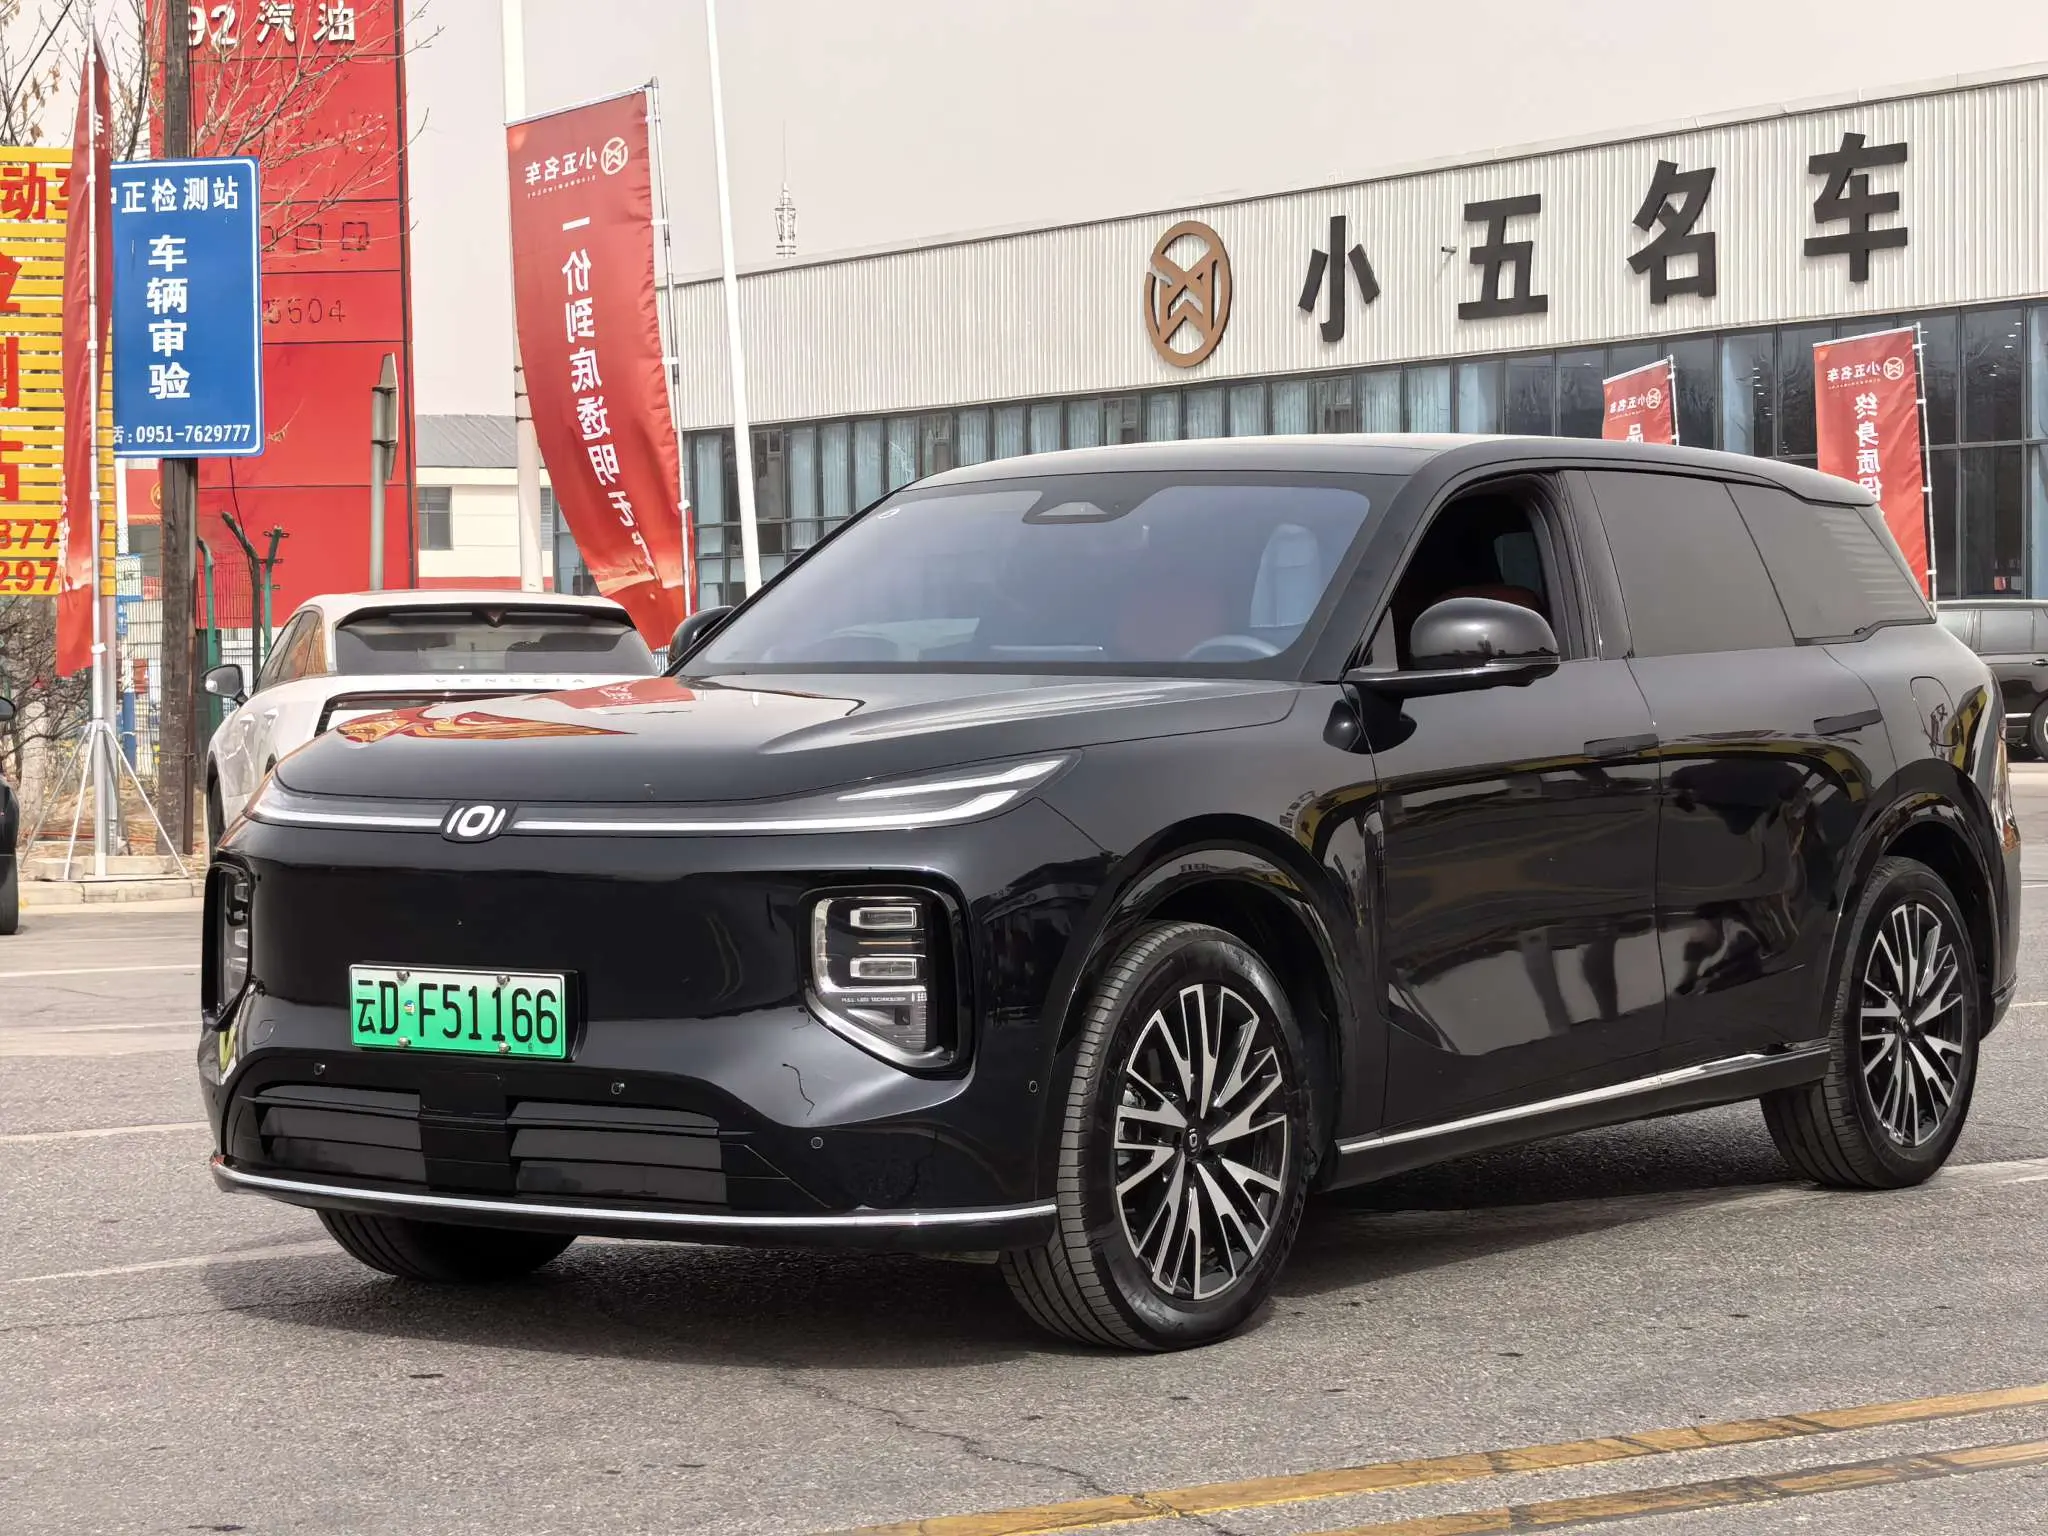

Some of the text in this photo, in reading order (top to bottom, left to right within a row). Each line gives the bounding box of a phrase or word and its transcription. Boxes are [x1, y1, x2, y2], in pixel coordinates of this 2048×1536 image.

[111, 175, 239, 213] 正检测站
[1298, 131, 1909, 343] 小五名车
[147, 234, 191, 400] 车辆审验
